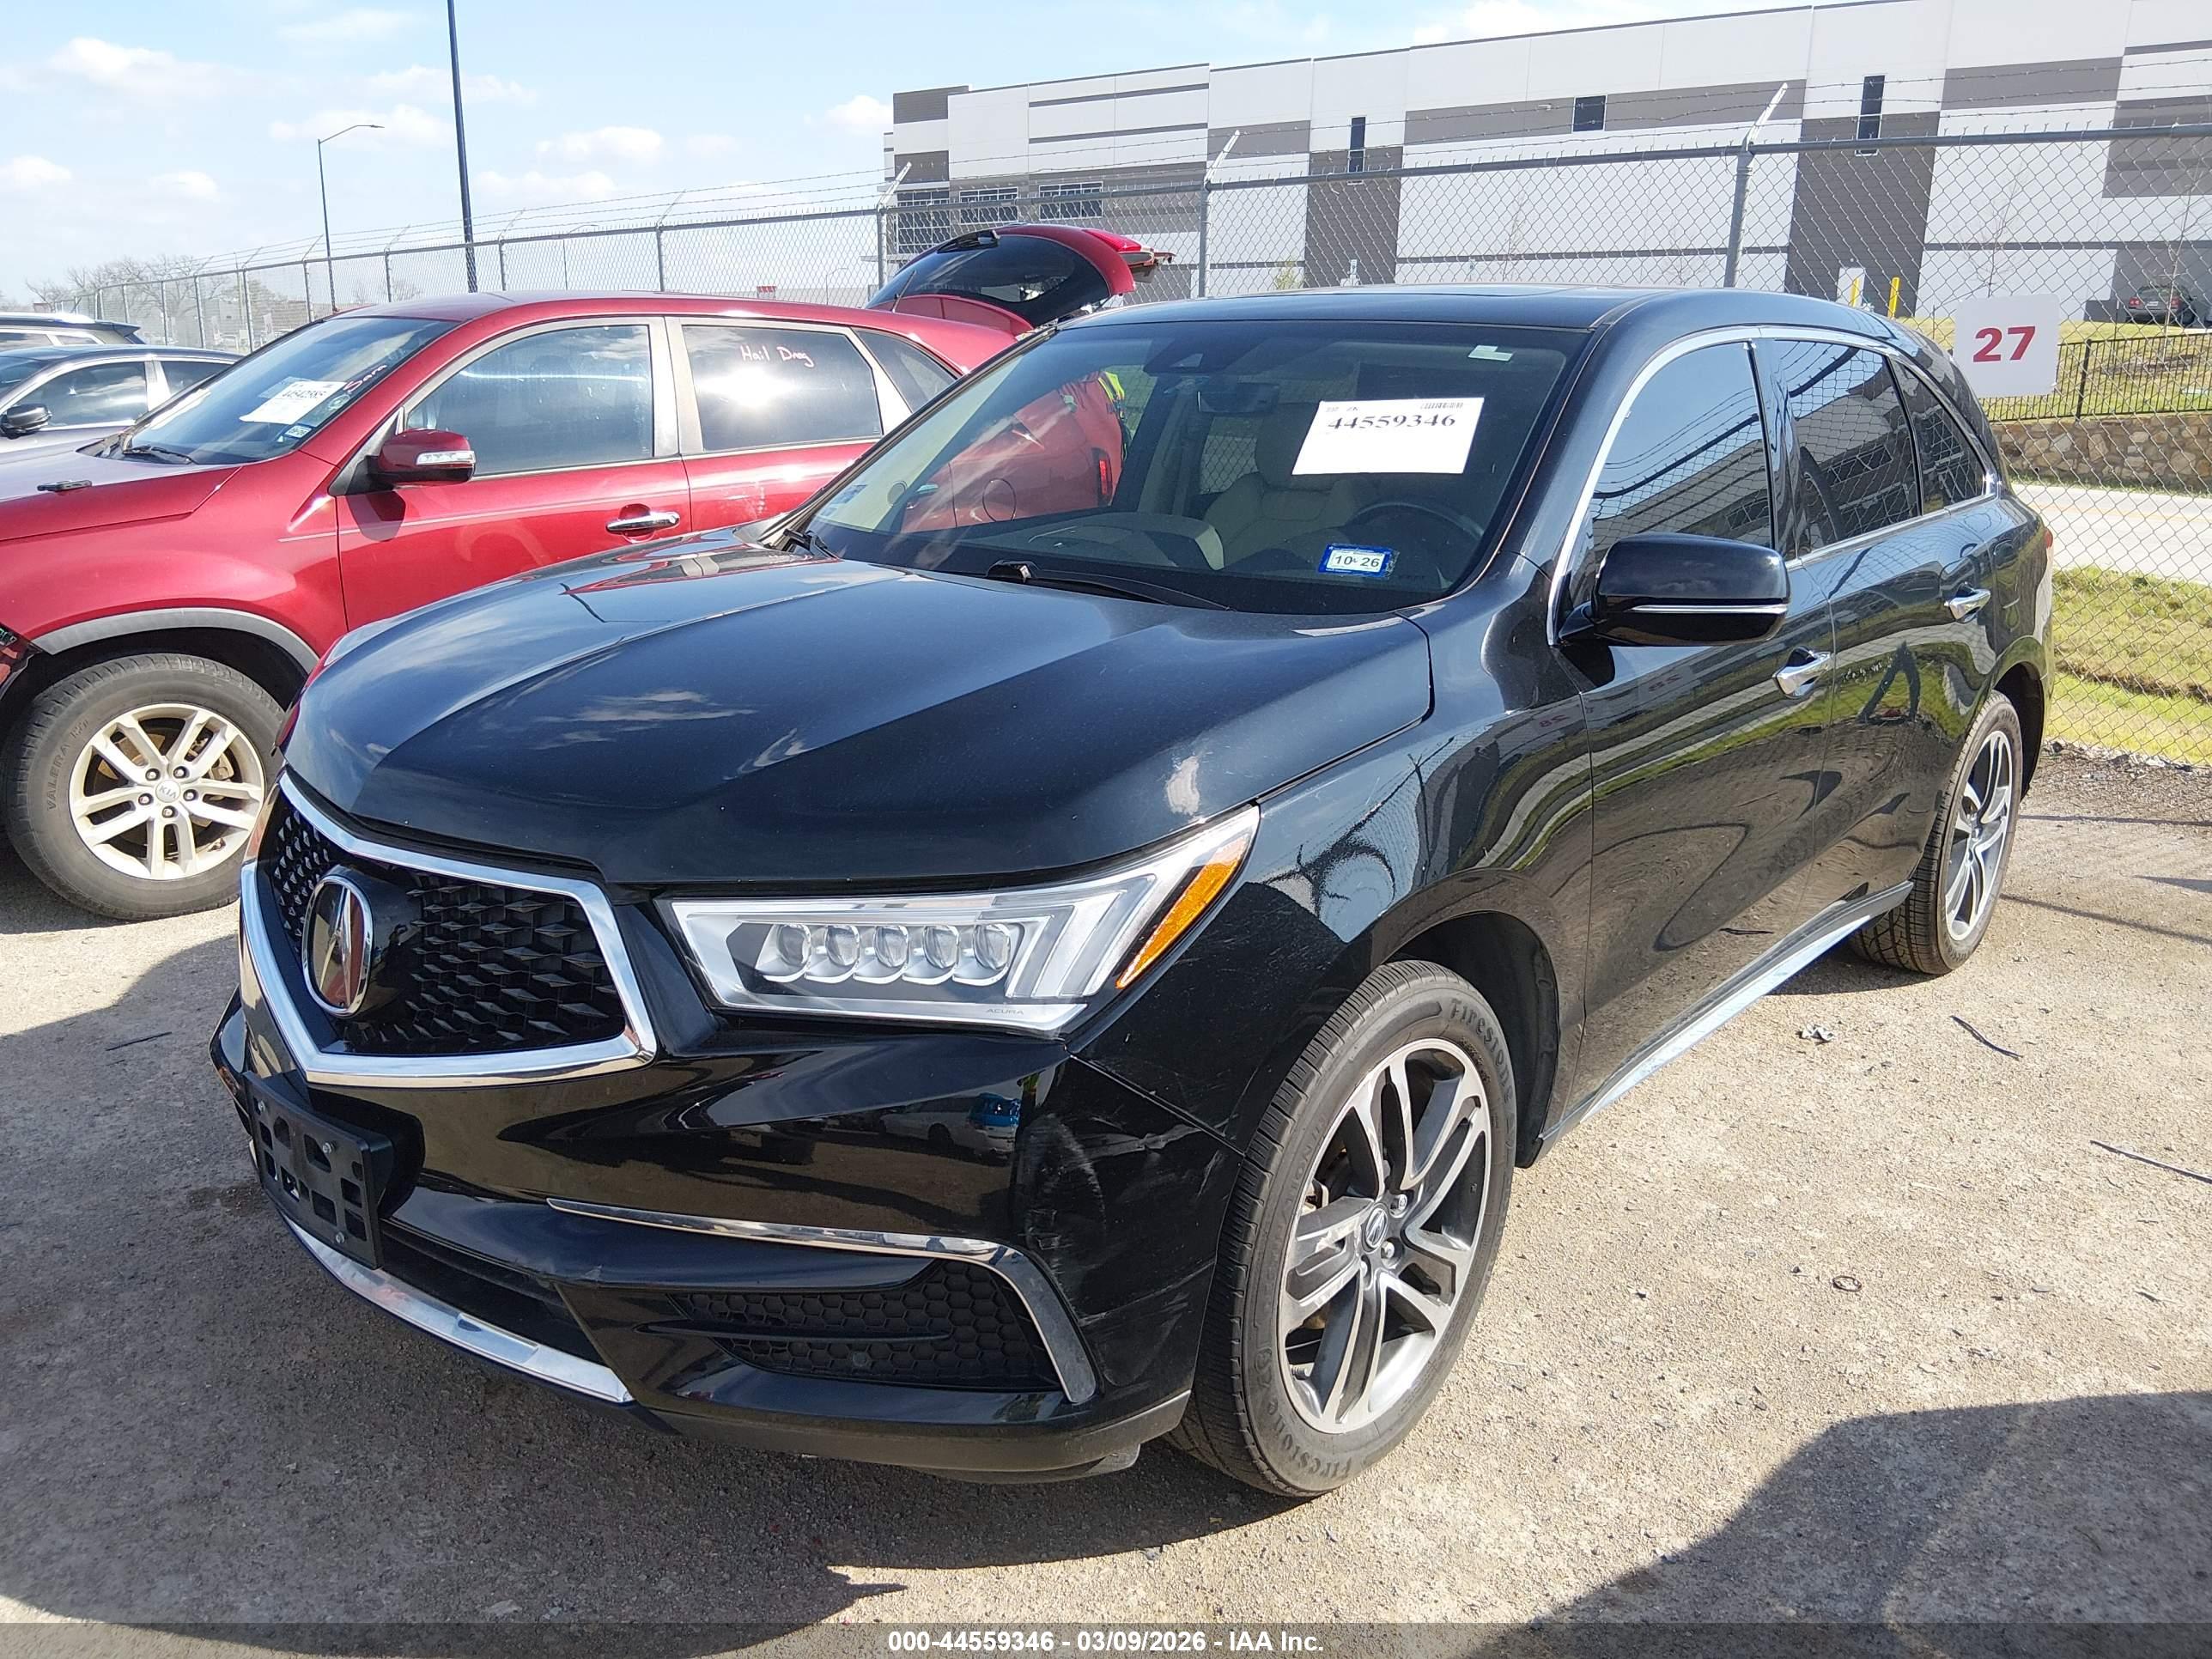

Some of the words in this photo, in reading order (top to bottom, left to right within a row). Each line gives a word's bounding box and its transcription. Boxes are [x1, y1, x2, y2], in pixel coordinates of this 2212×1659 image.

[1972, 325, 2036, 362] 27
[740, 345, 770, 362] Hail
[1328, 413, 1456, 430] 44559346
[1334, 555, 1352, 565] 10
[1360, 557, 1380, 568] 26
[46, 743, 70, 811] VALERA
[159, 783, 177, 799] KIA
[986, 1007, 1024, 1016] ACURA
